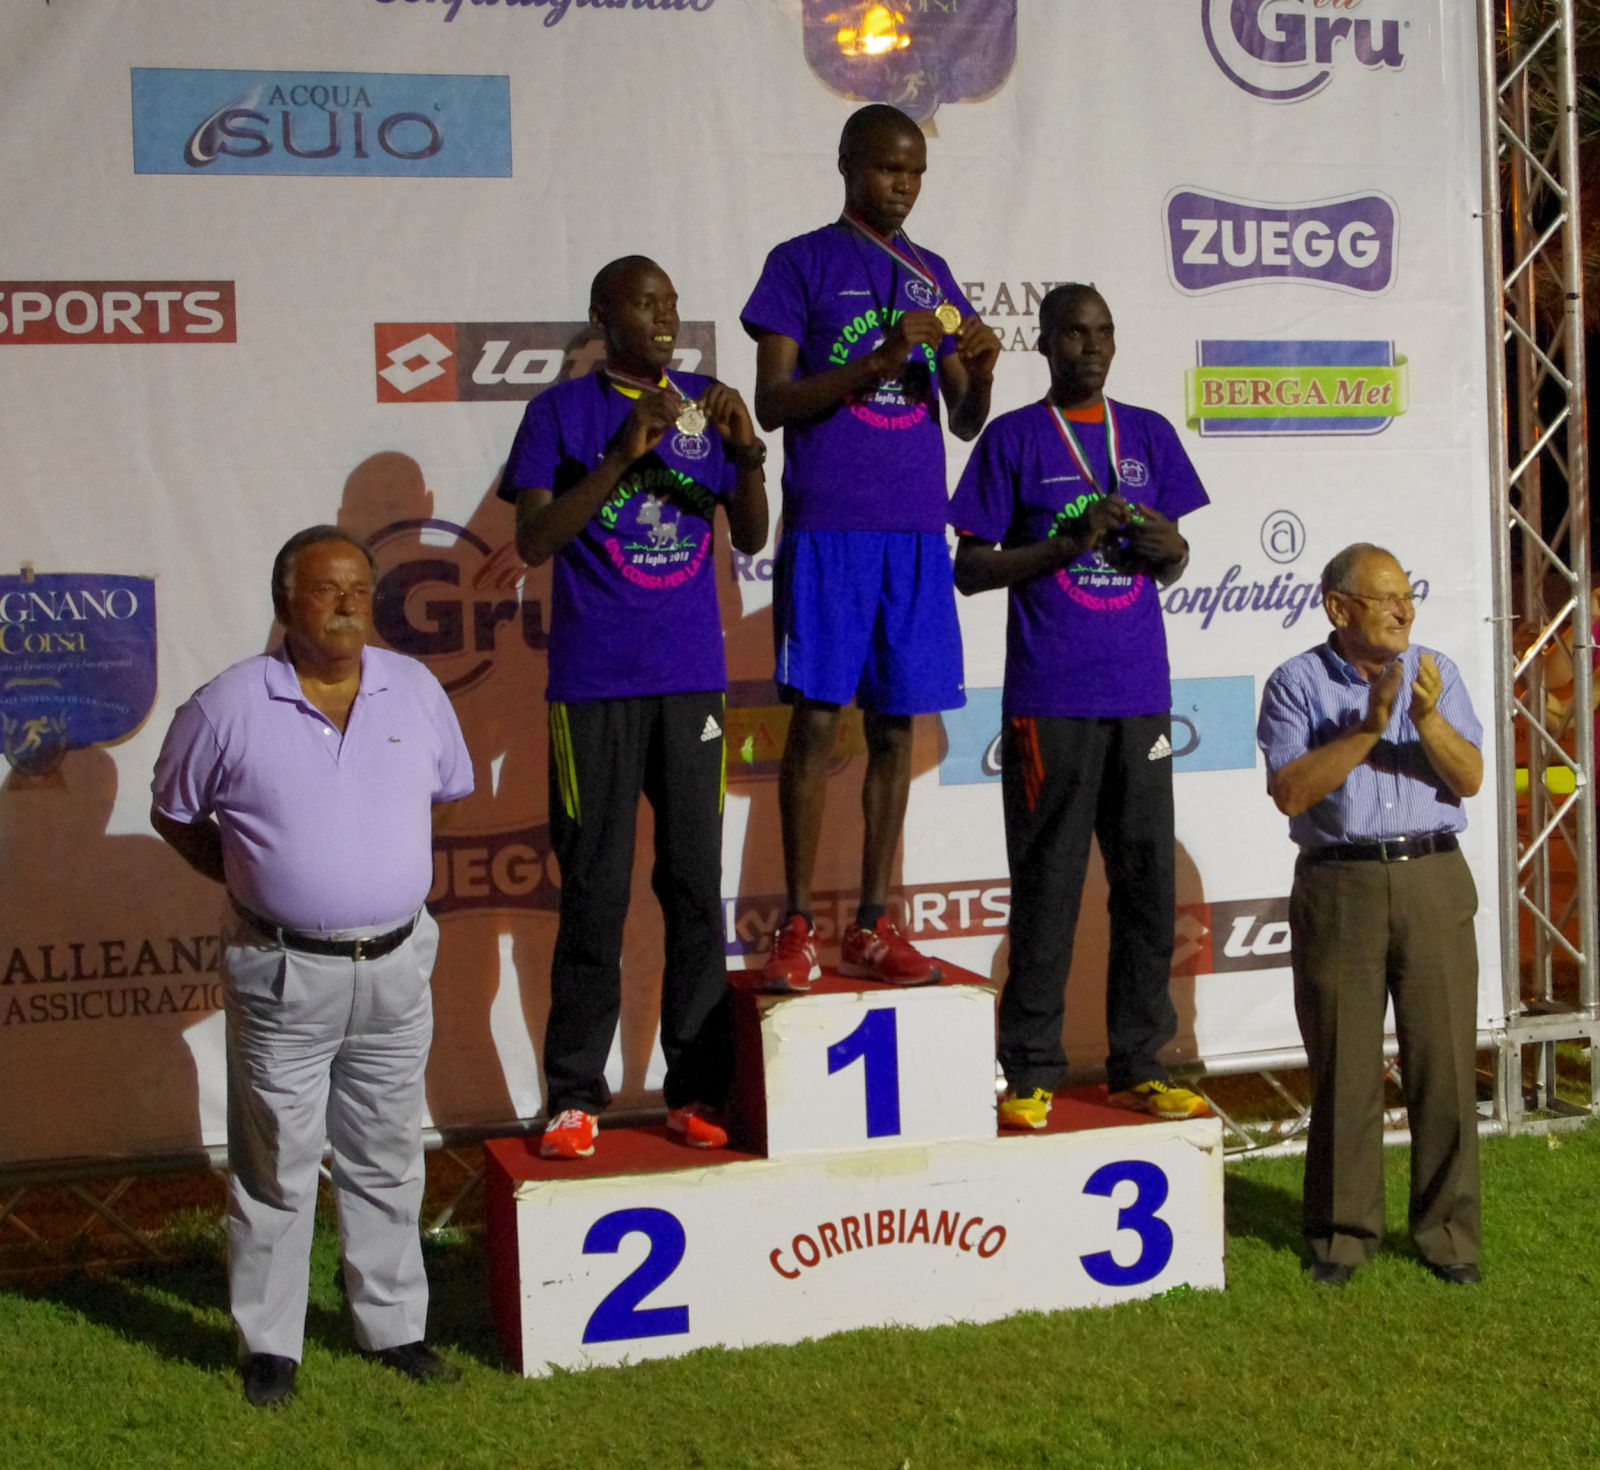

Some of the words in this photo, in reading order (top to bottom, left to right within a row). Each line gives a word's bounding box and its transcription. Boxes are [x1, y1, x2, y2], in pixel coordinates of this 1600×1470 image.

[1230, 0, 1404, 67] Gru
[268, 84, 372, 112] ACQUA
[216, 108, 444, 160] SUIO
[1181, 218, 1381, 269] ZUEGG
[0, 290, 224, 335] PORTS
[1202, 379, 1328, 406] BERGA
[1334, 378, 1393, 406] Met
[0, 588, 138, 624] GNANO
[372, 558, 551, 656] Gru
[827, 1006, 901, 1139] 1
[769, 1207, 1007, 1280] CORRIBIANCO
[1079, 1160, 1174, 1287] 3
[581, 1206, 690, 1345] 2
